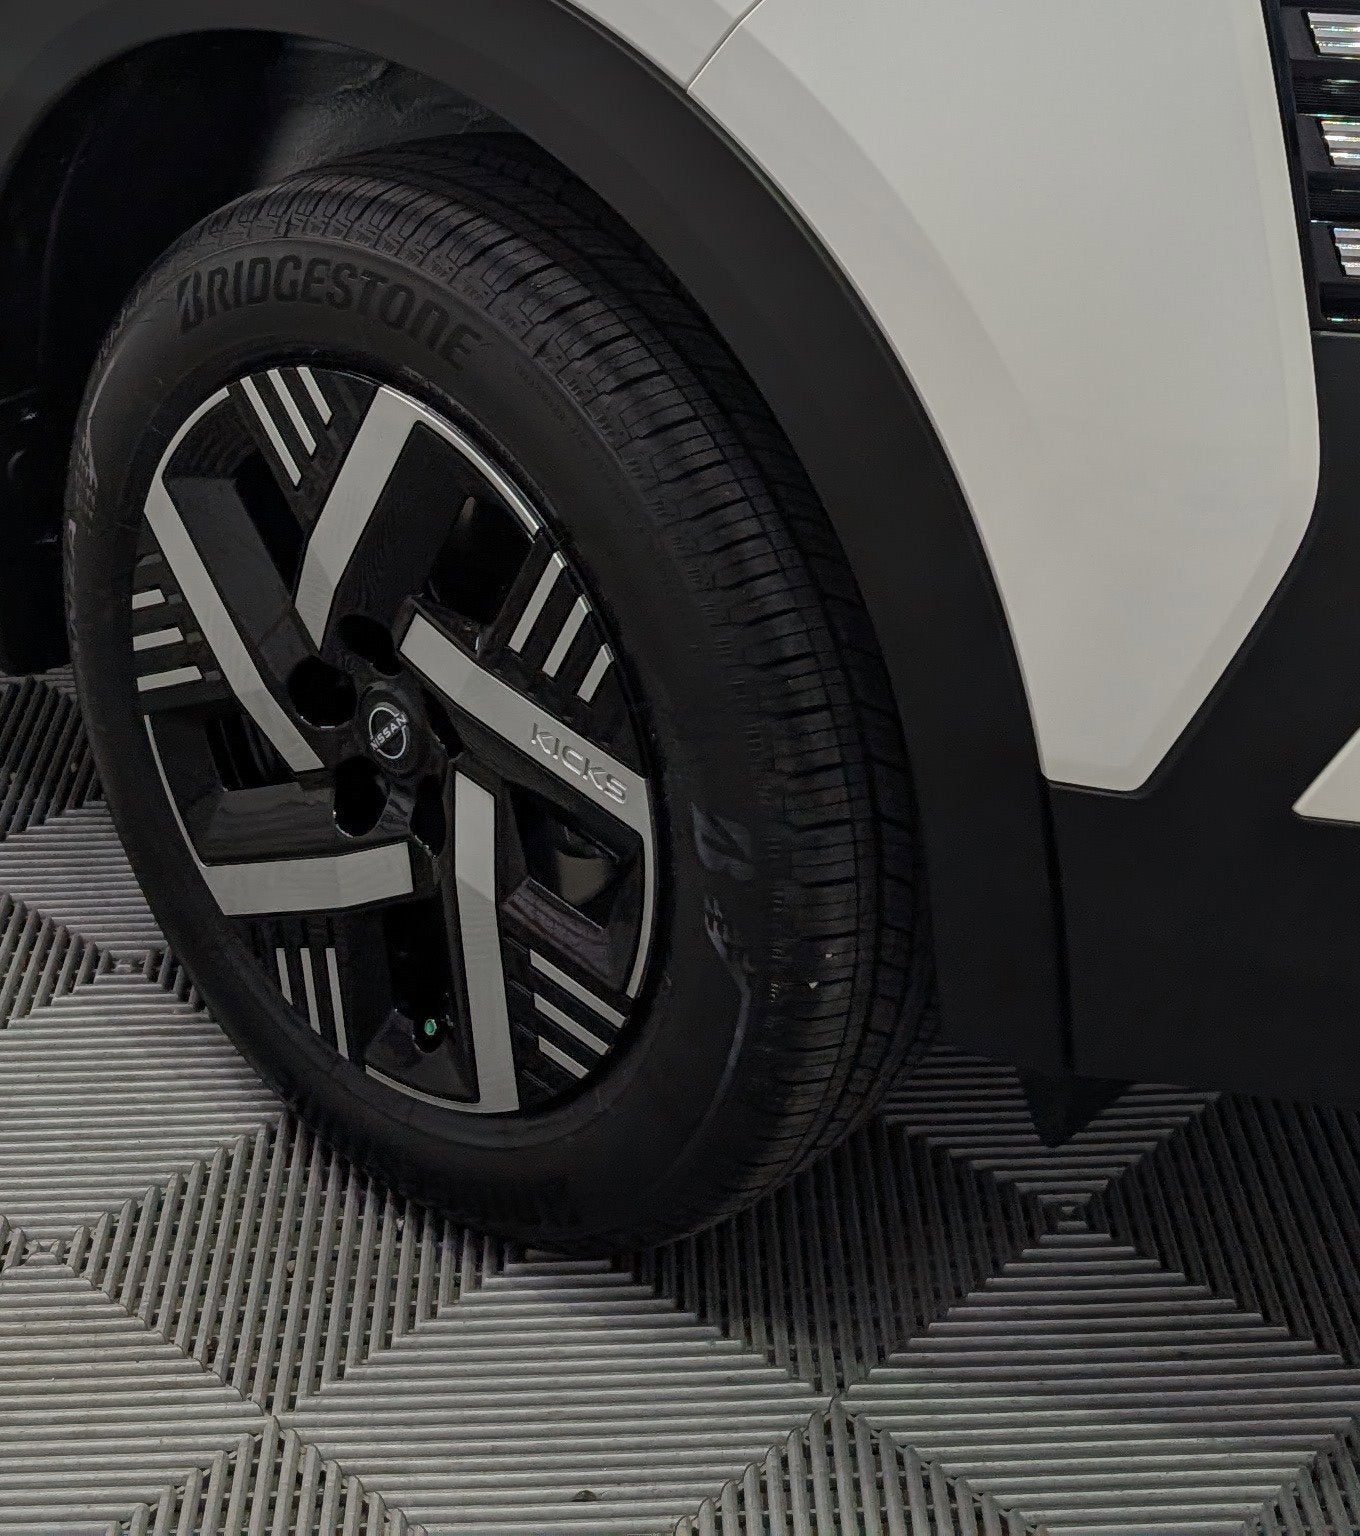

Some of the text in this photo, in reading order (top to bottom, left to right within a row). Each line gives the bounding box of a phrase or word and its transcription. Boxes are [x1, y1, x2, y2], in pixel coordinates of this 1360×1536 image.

[176, 254, 484, 370] BRIDGESTONE
[370, 711, 408, 751] NISSAN
[530, 722, 628, 805] KICKS
